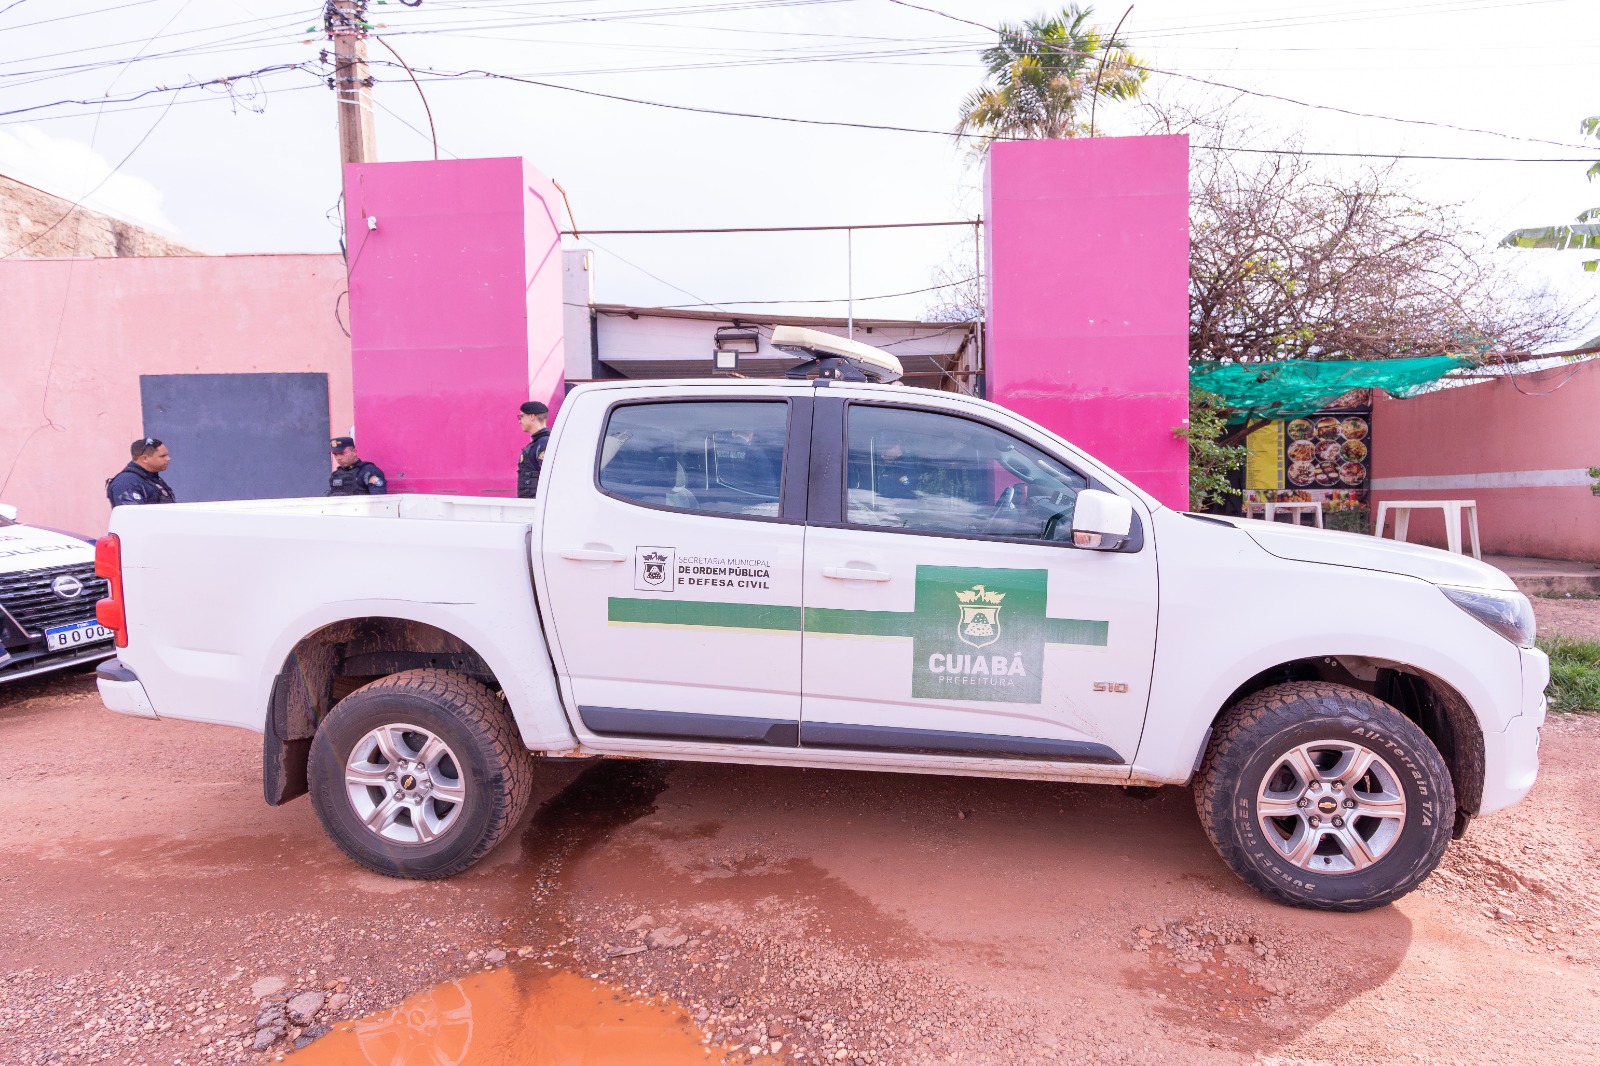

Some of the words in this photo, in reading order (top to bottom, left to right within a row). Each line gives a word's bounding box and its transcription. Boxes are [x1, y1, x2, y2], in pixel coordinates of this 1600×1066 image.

[678, 556, 726, 565] SECRETARIA
[727, 559, 771, 567] MUNICIPAL
[678, 565, 690, 574] DE
[692, 566, 727, 575] ORDEM
[728, 566, 770, 578] PÚBLICA
[678, 577, 685, 585] E
[688, 578, 734, 587] DEFESA
[737, 580, 770, 589] CIVIL
[928, 651, 1026, 677] CUIABÁ
[938, 675, 1015, 687] PREFEITURA
[1093, 681, 1129, 694] S10
[1351, 727, 1429, 796] All-Terrain
[1421, 801, 1433, 826] T/A
[1239, 798, 1257, 847] TIRES
[1254, 852, 1316, 893] SUNSET
